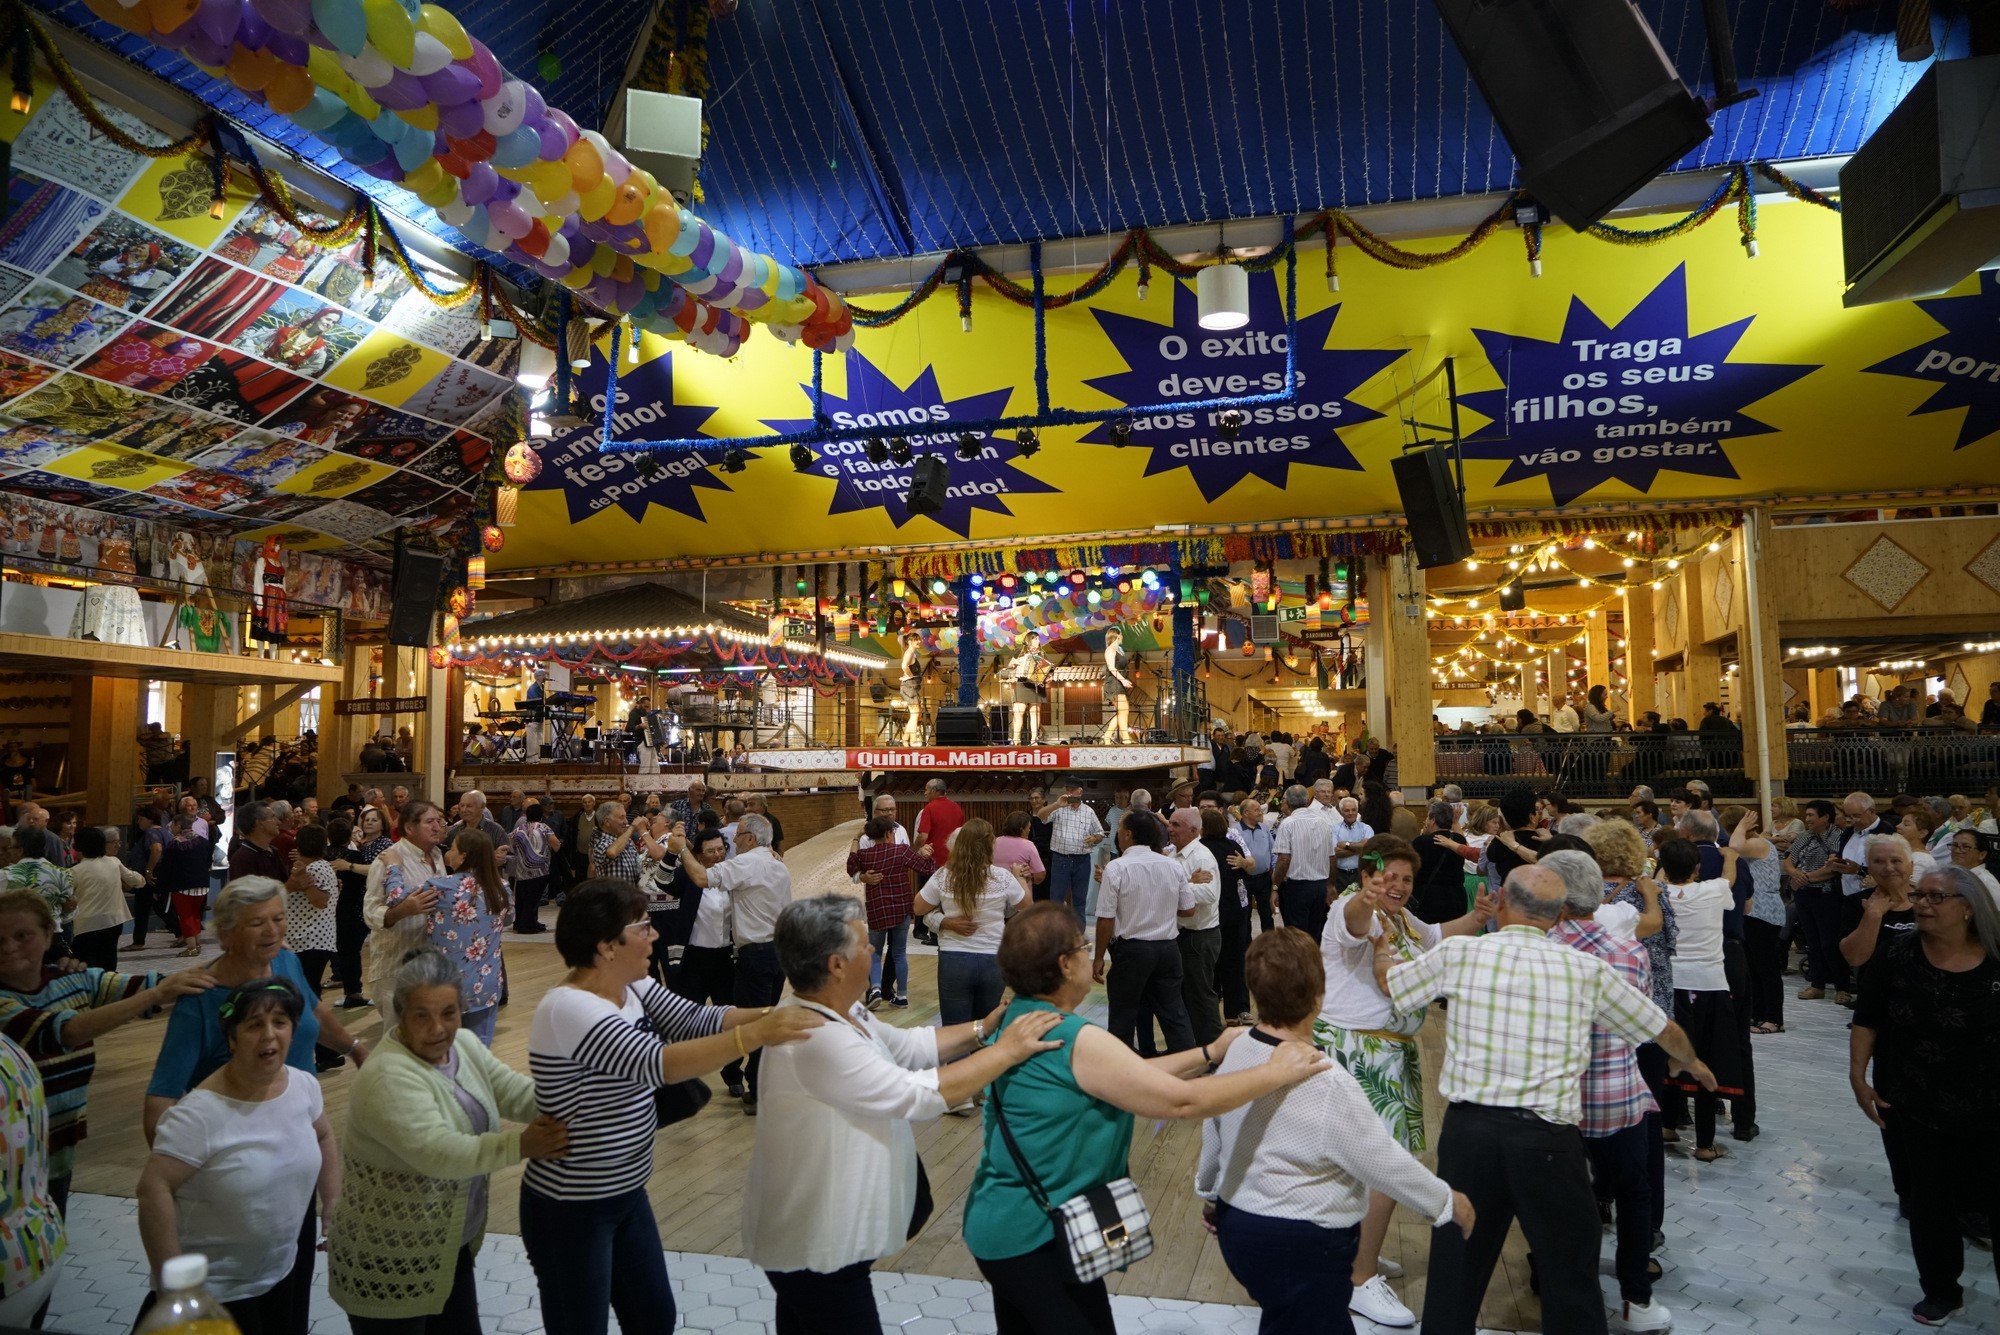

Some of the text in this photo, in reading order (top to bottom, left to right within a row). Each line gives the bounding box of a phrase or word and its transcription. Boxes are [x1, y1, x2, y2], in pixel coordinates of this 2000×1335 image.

[1159, 331, 1292, 361] O exito
[1572, 337, 1683, 363] Traga
[1158, 370, 1306, 398] deve-se
[1562, 364, 1715, 390] os seus
[832, 404, 950, 431] Somos
[1511, 394, 1658, 424] filhos,
[552, 400, 667, 467] na melhor
[1131, 412, 1196, 432] aos
[1594, 417, 1732, 439] também
[1169, 433, 1311, 458] clientes
[1518, 441, 1718, 466] vão gostar.
[823, 464, 840, 477] e
[853, 474, 912, 492] todo
[589, 494, 611, 510] de
[857, 751, 935, 767] Quinta
[949, 750, 1058, 767] Malafaia
